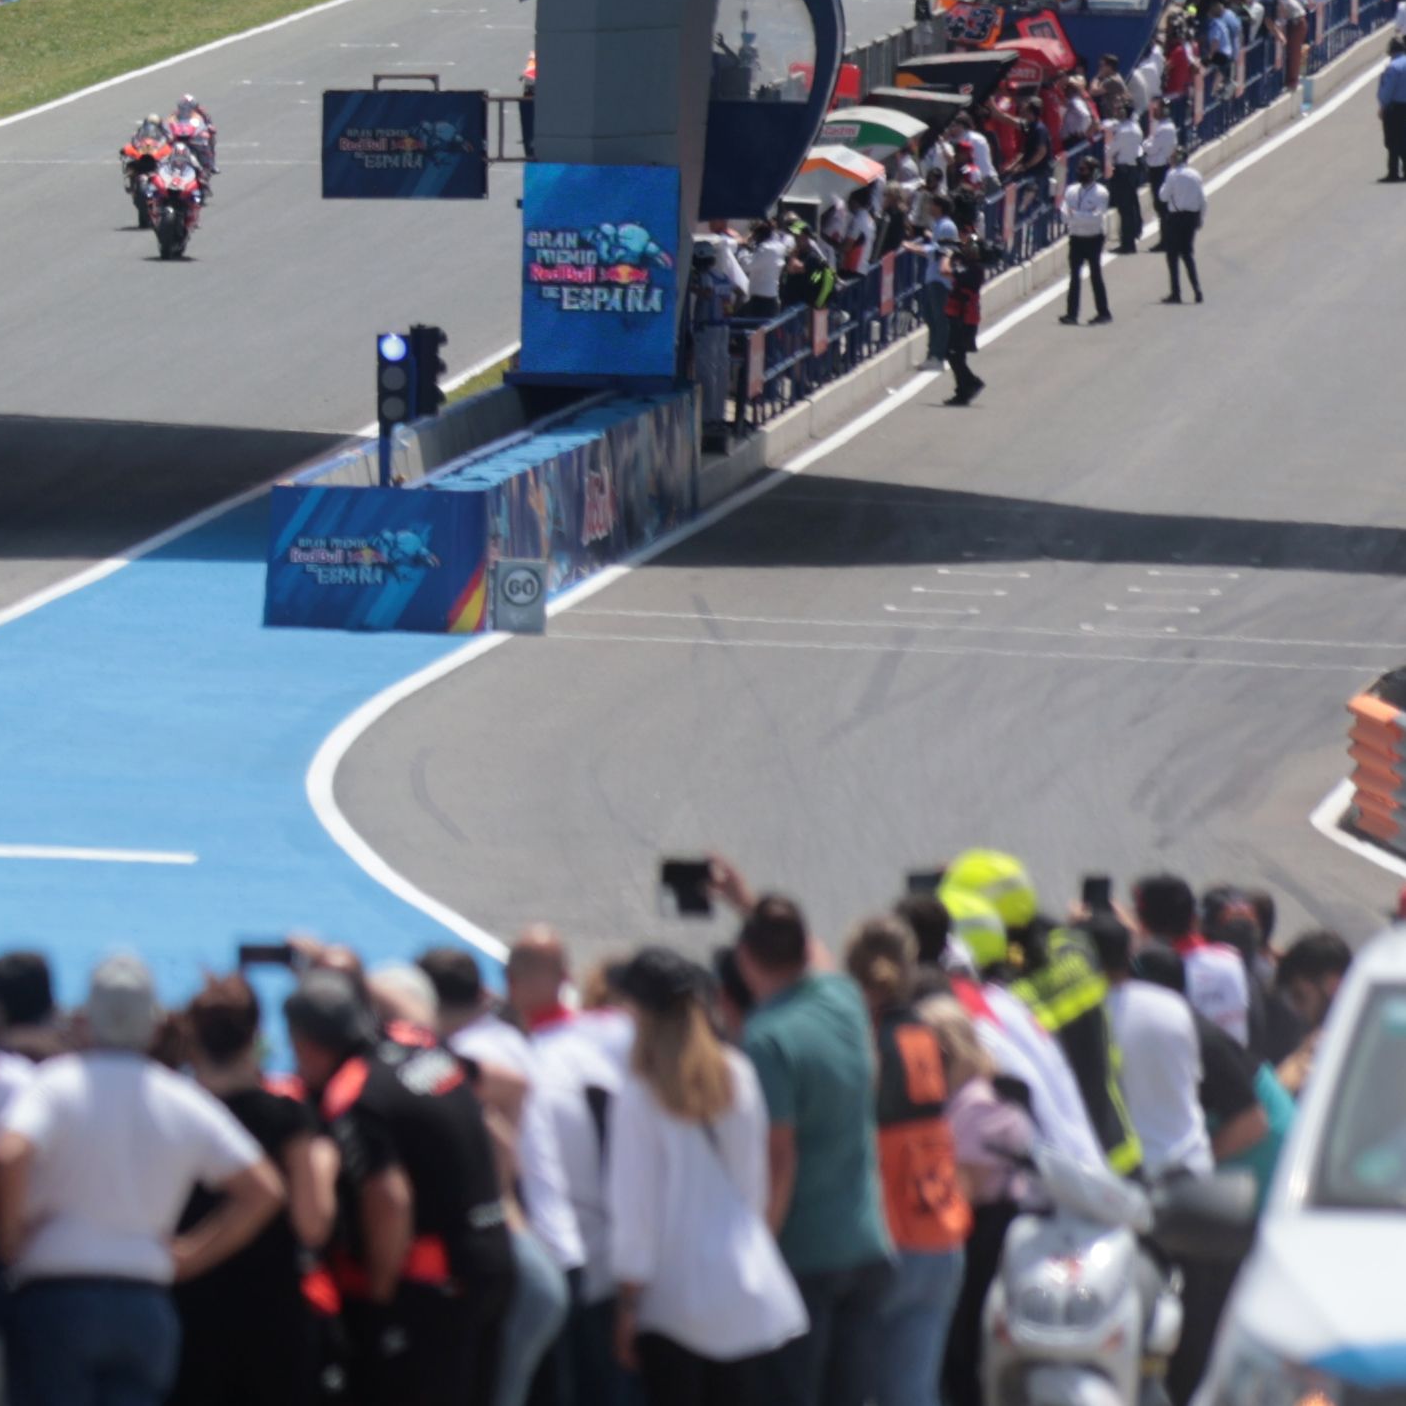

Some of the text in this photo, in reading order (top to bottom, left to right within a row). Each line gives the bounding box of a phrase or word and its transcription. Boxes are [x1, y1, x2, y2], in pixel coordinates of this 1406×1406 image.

[526, 231, 579, 248] GRAN
[561, 284, 664, 312] ESPAÑA
[317, 565, 384, 585] ESPAÑA
[508, 579, 537, 596] 60
